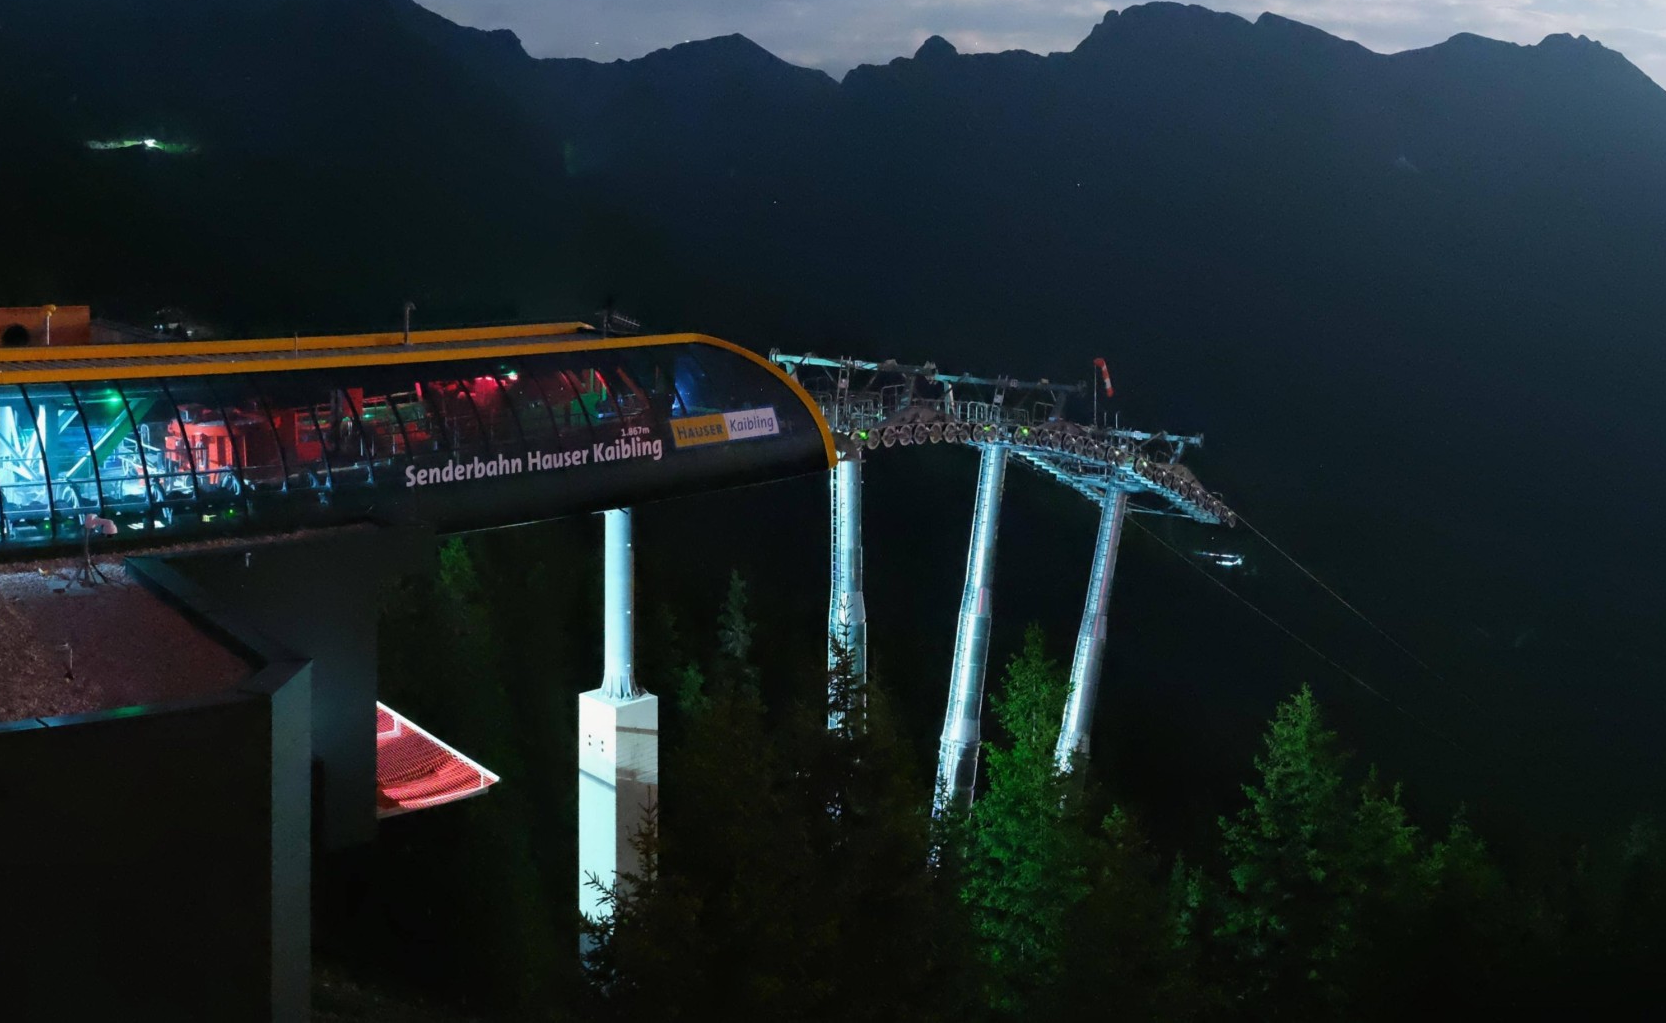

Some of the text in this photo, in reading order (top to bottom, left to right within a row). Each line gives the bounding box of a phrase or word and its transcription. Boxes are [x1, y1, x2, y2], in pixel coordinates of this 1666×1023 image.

[621, 426, 650, 437] 1.867m
[677, 416, 774, 440] HAUSER Kaibling
[405, 436, 663, 488] Senderbahn Hauser Kaibling
